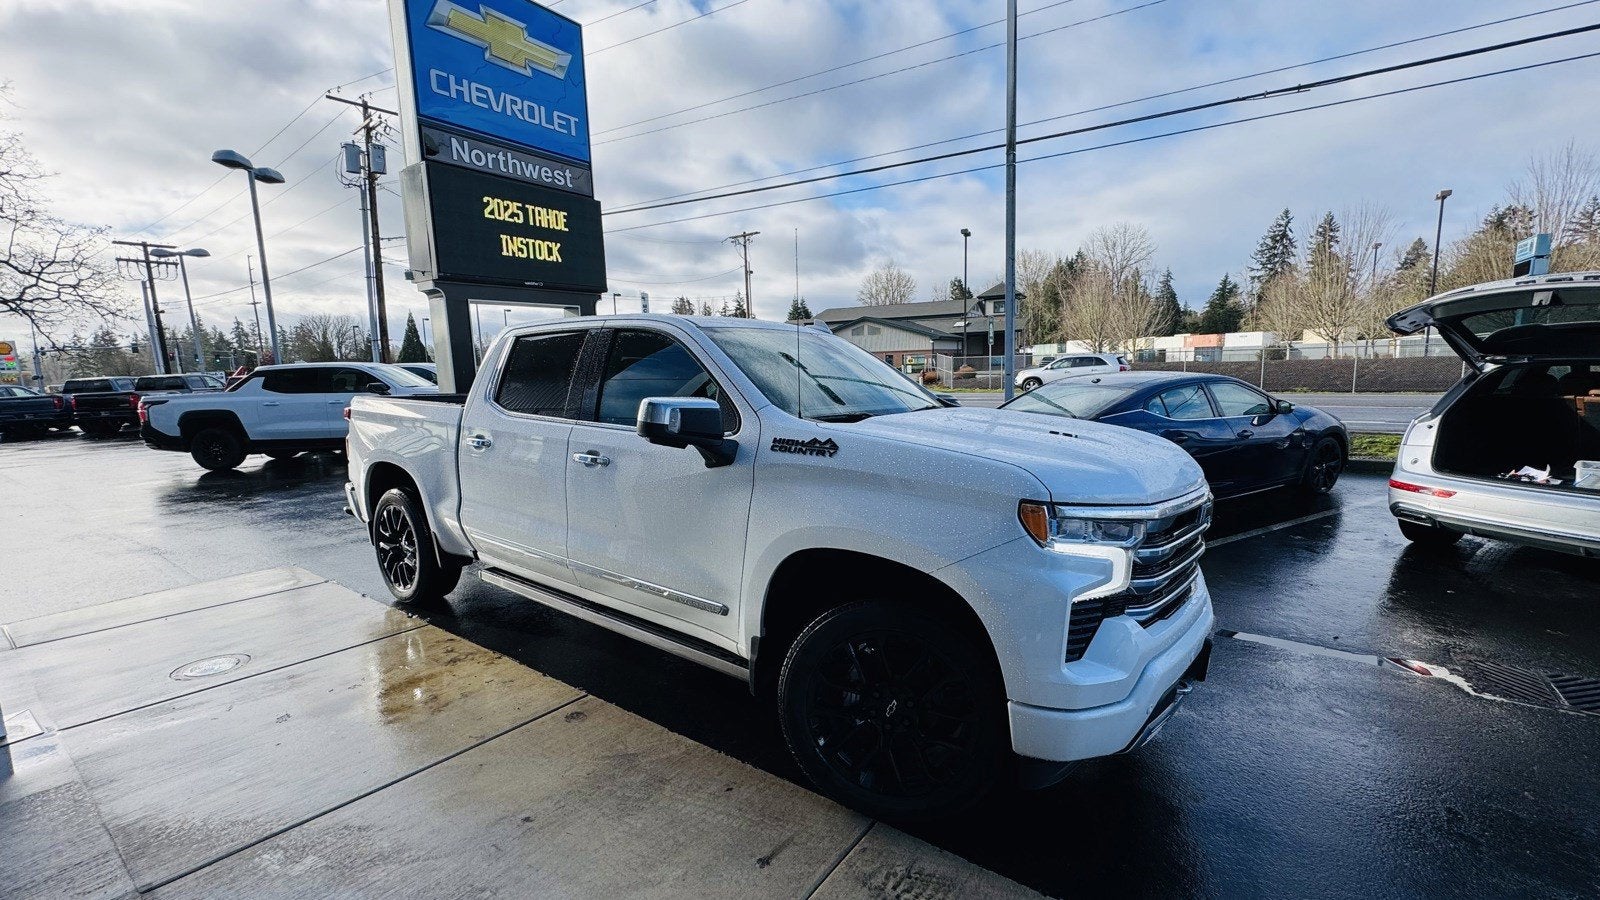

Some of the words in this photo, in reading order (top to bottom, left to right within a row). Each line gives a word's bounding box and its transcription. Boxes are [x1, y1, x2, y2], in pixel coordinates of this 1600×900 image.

[429, 68, 579, 136] CHEVROLET
[451, 137, 573, 188] Northwest
[483, 196, 524, 223] 2025
[525, 204, 569, 231] TAHOE
[500, 234, 562, 263] INSTOCK
[770, 444, 838, 458] COUNTRY
[772, 437, 806, 447] HIGH
